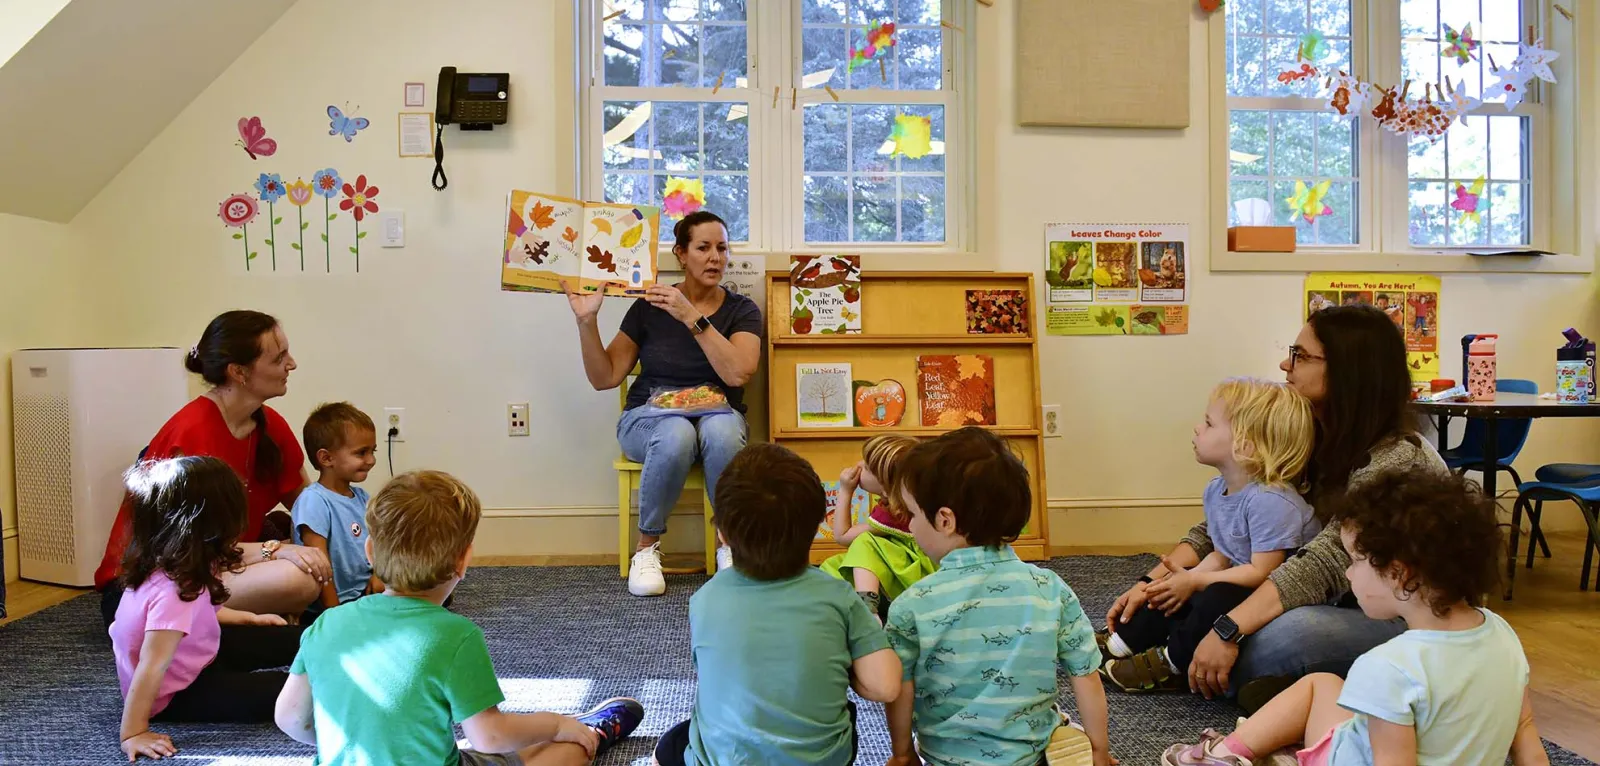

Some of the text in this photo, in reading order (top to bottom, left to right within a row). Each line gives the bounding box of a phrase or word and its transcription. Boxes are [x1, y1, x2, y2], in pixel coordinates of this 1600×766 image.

[1071, 230, 1162, 240] Leaves Change Color
[807, 298, 830, 307] Apple
[820, 367, 832, 375] Not
[834, 368, 848, 376] Easy
[924, 373, 941, 382] Red
[925, 391, 951, 400] Yellow
